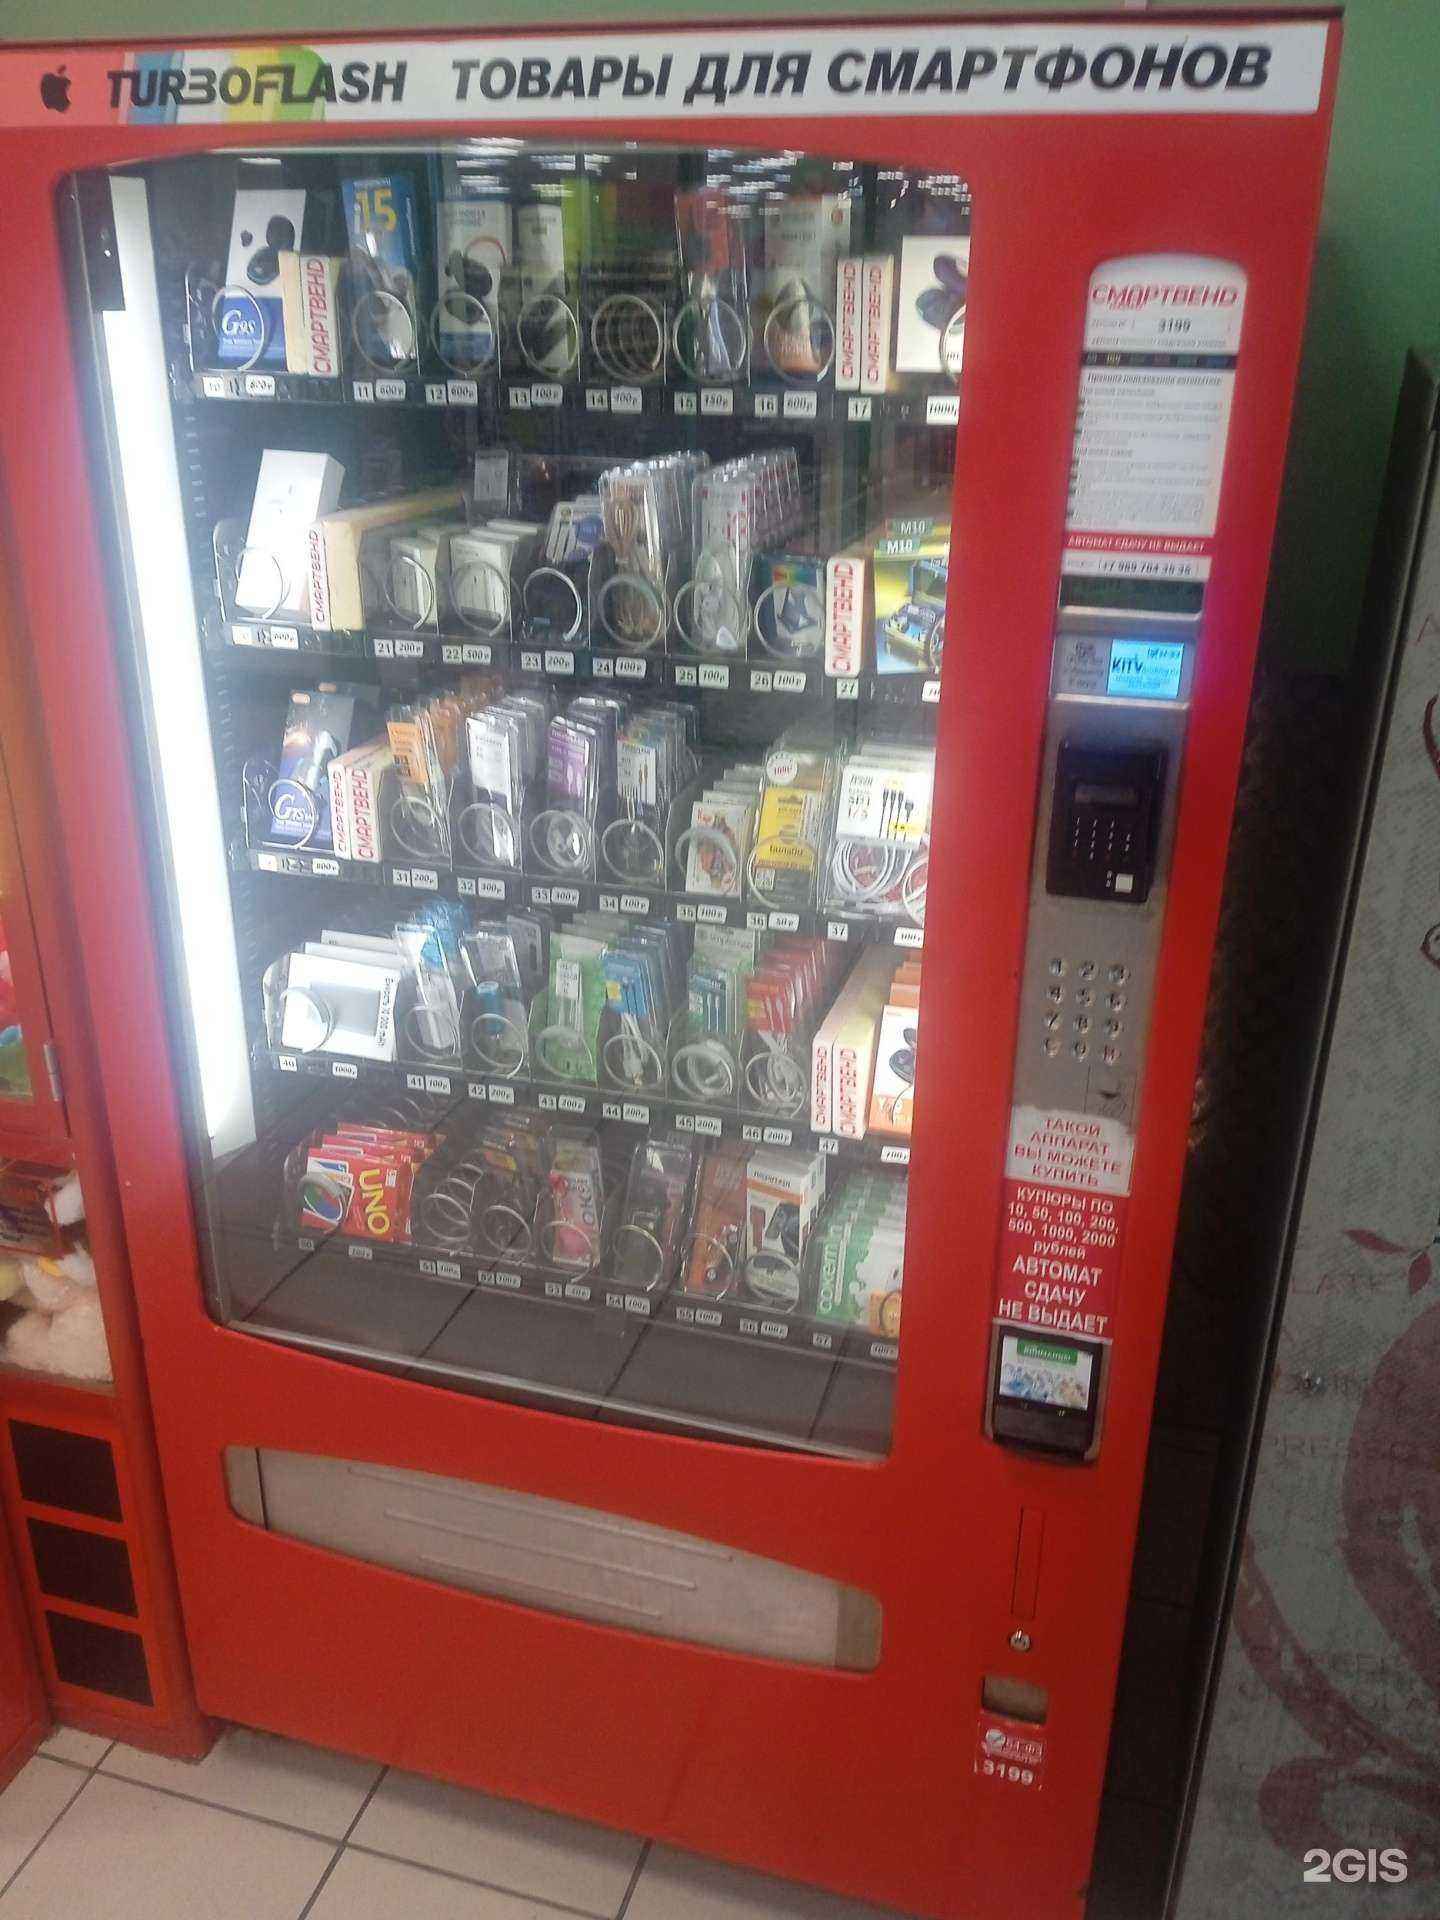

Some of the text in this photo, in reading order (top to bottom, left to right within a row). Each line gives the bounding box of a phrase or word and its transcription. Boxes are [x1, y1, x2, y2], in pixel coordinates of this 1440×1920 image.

[452, 44, 1273, 107] ТОВАРЫ ДЛЯ СМАРТФОНОВ
[430, 388, 445, 401] 12
[851, 401, 868, 416] 17
[446, 648, 460, 660] 22
[754, 673, 769, 686] 26
[831, 925, 847, 937] 37
[471, 1086, 484, 1097] 42
[1046, 1117, 1101, 1137] ТАКОЙ
[1030, 1132, 1110, 1155] АППАРАТ
[1014, 1144, 1122, 1175] ВЫ МОЖЕТЕ
[1032, 1164, 1098, 1187] КУПИТЬ
[358, 1168, 391, 1236] UNO
[1017, 1186, 1114, 1214] КУПЮРЫ ПО
[1007, 1201, 1028, 1218] 10,
[1058, 1210, 1086, 1228] 100,
[1089, 1217, 1120, 1234] 200,
[1008, 1218, 1116, 1249] 500, 1000, 2000
[1033, 1240, 1087, 1260] рублей
[1012, 1254, 1104, 1288] АВТОМАТ
[1024, 1279, 1086, 1309] СДАЧУ
[998, 1296, 1110, 1336] НЕ ВЫДАЕТ
[983, 1760, 1034, 1785] 3199
